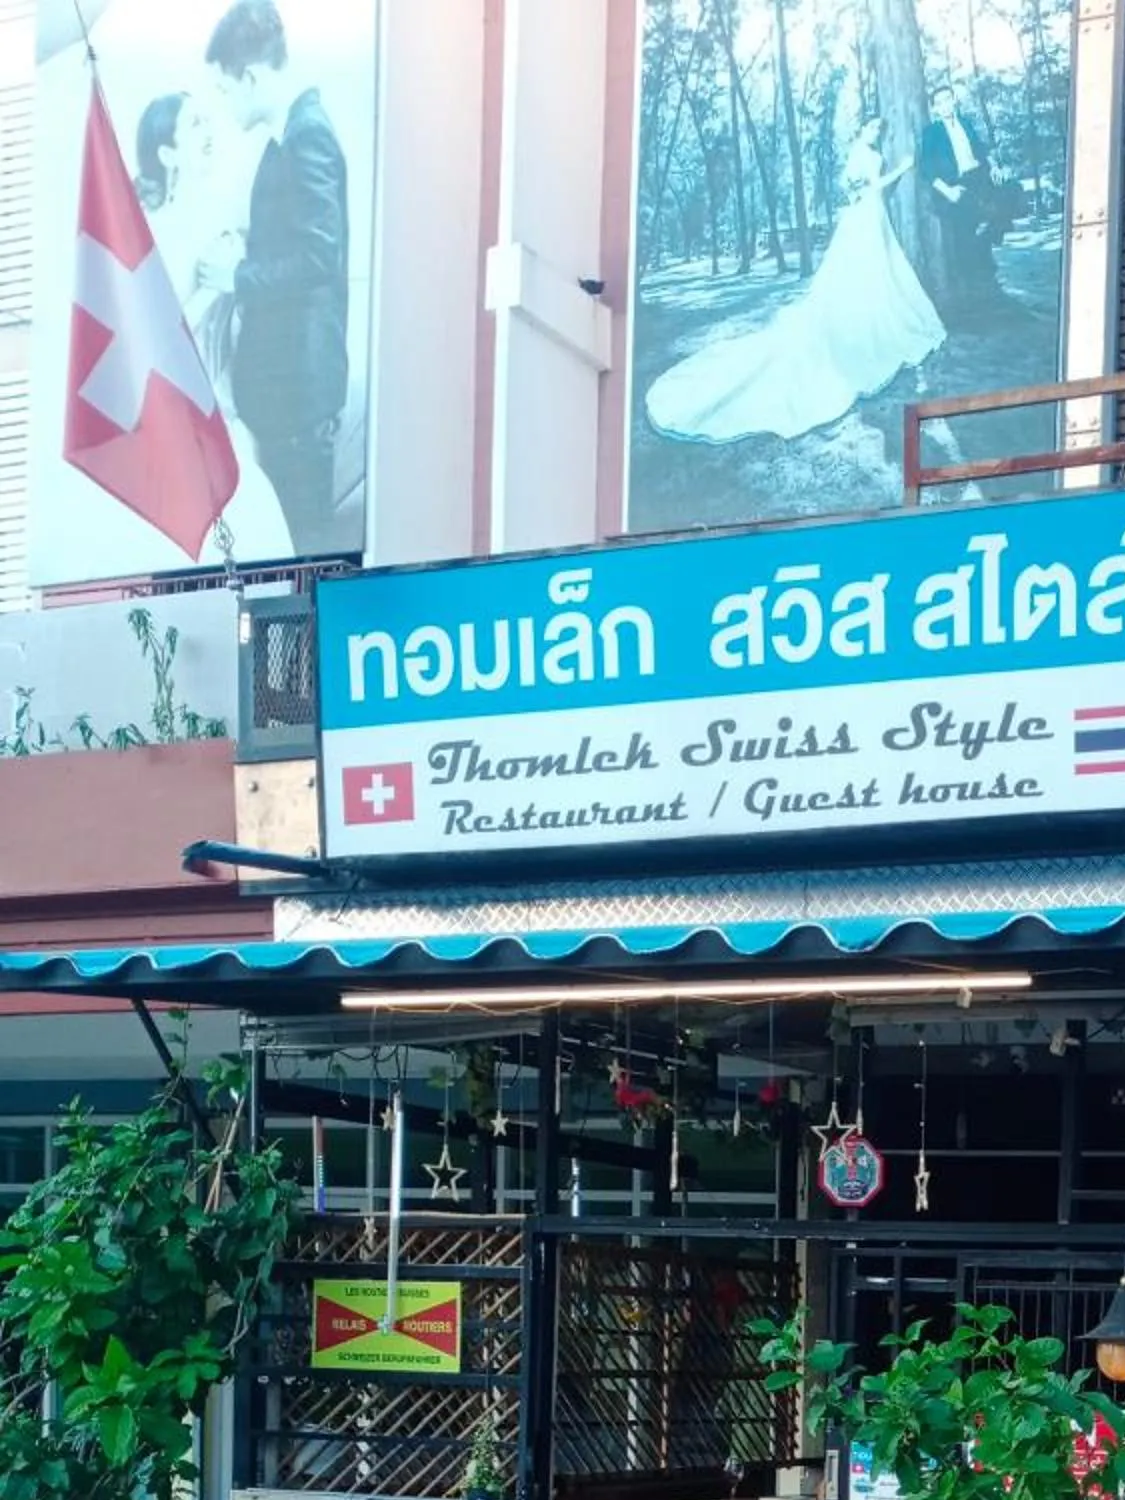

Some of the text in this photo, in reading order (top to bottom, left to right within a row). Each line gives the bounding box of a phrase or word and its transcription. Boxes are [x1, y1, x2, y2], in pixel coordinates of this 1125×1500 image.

[348, 568, 656, 701] ทอมเล็ก
[709, 563, 891, 669] สวิส
[427, 701, 1054, 785] Thomlek Swiss Style
[440, 791, 689, 836] Restaurant
[743, 777, 882, 820] Guest
[898, 772, 1044, 805] house
